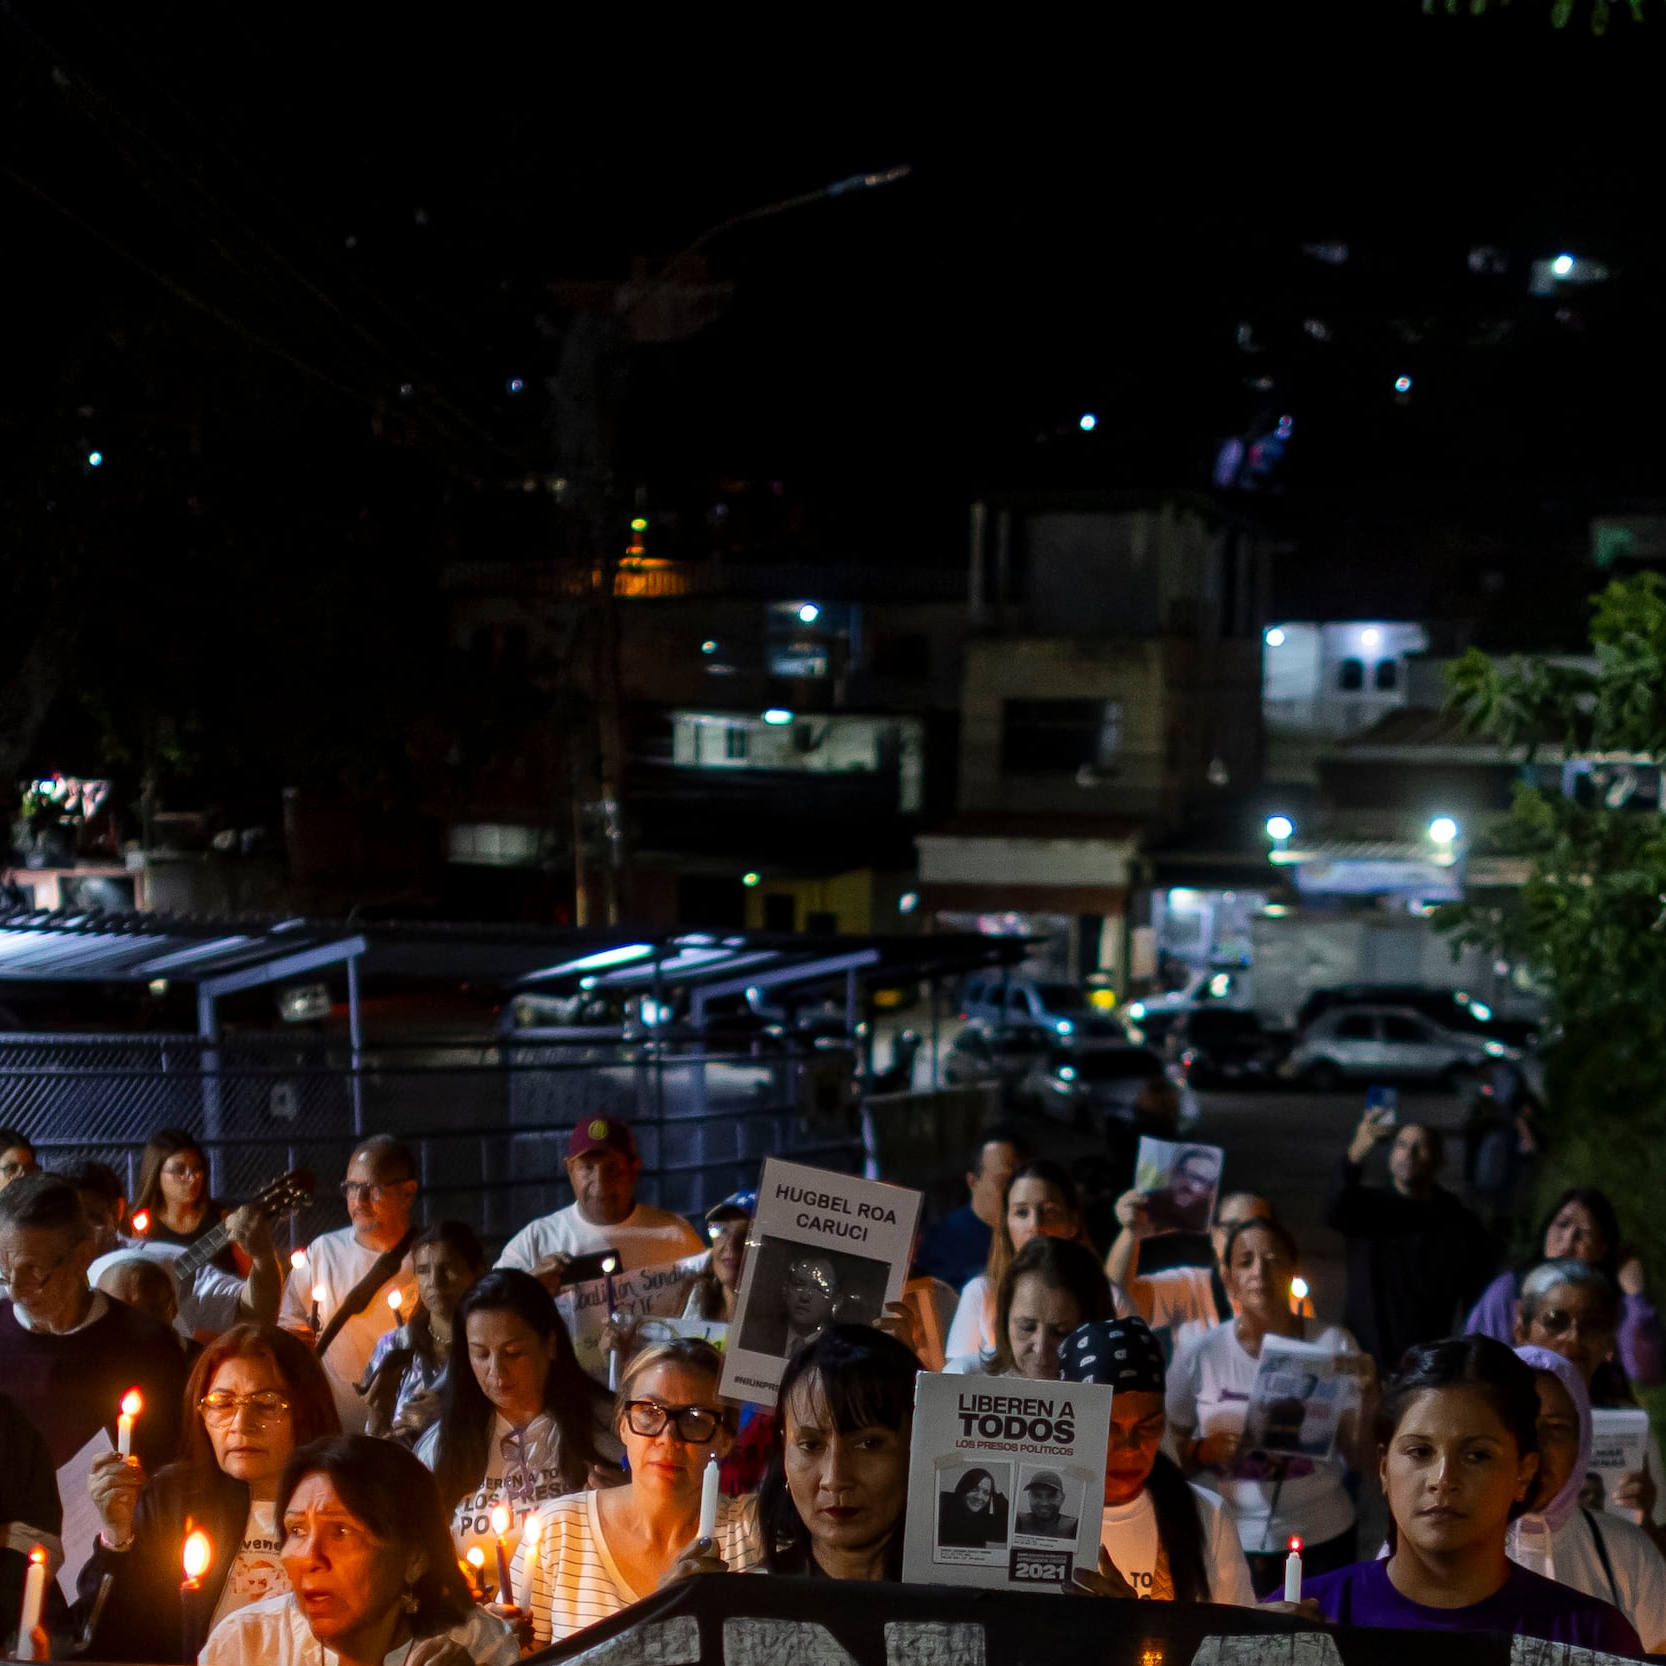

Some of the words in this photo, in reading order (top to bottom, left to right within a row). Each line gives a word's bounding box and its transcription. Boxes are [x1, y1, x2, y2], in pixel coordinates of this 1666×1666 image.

[776, 1184, 852, 1215] HUGBEL
[858, 1203, 897, 1225] ROA
[796, 1213, 868, 1242] CARUCI
[958, 1393, 1054, 1418] LIBEREN
[1059, 1401, 1075, 1419] A
[958, 1413, 1075, 1445] TODOS
[956, 1440, 976, 1449] LOS
[977, 1440, 1018, 1452] PRESOS
[1015, 1563, 1066, 1580] 2021
